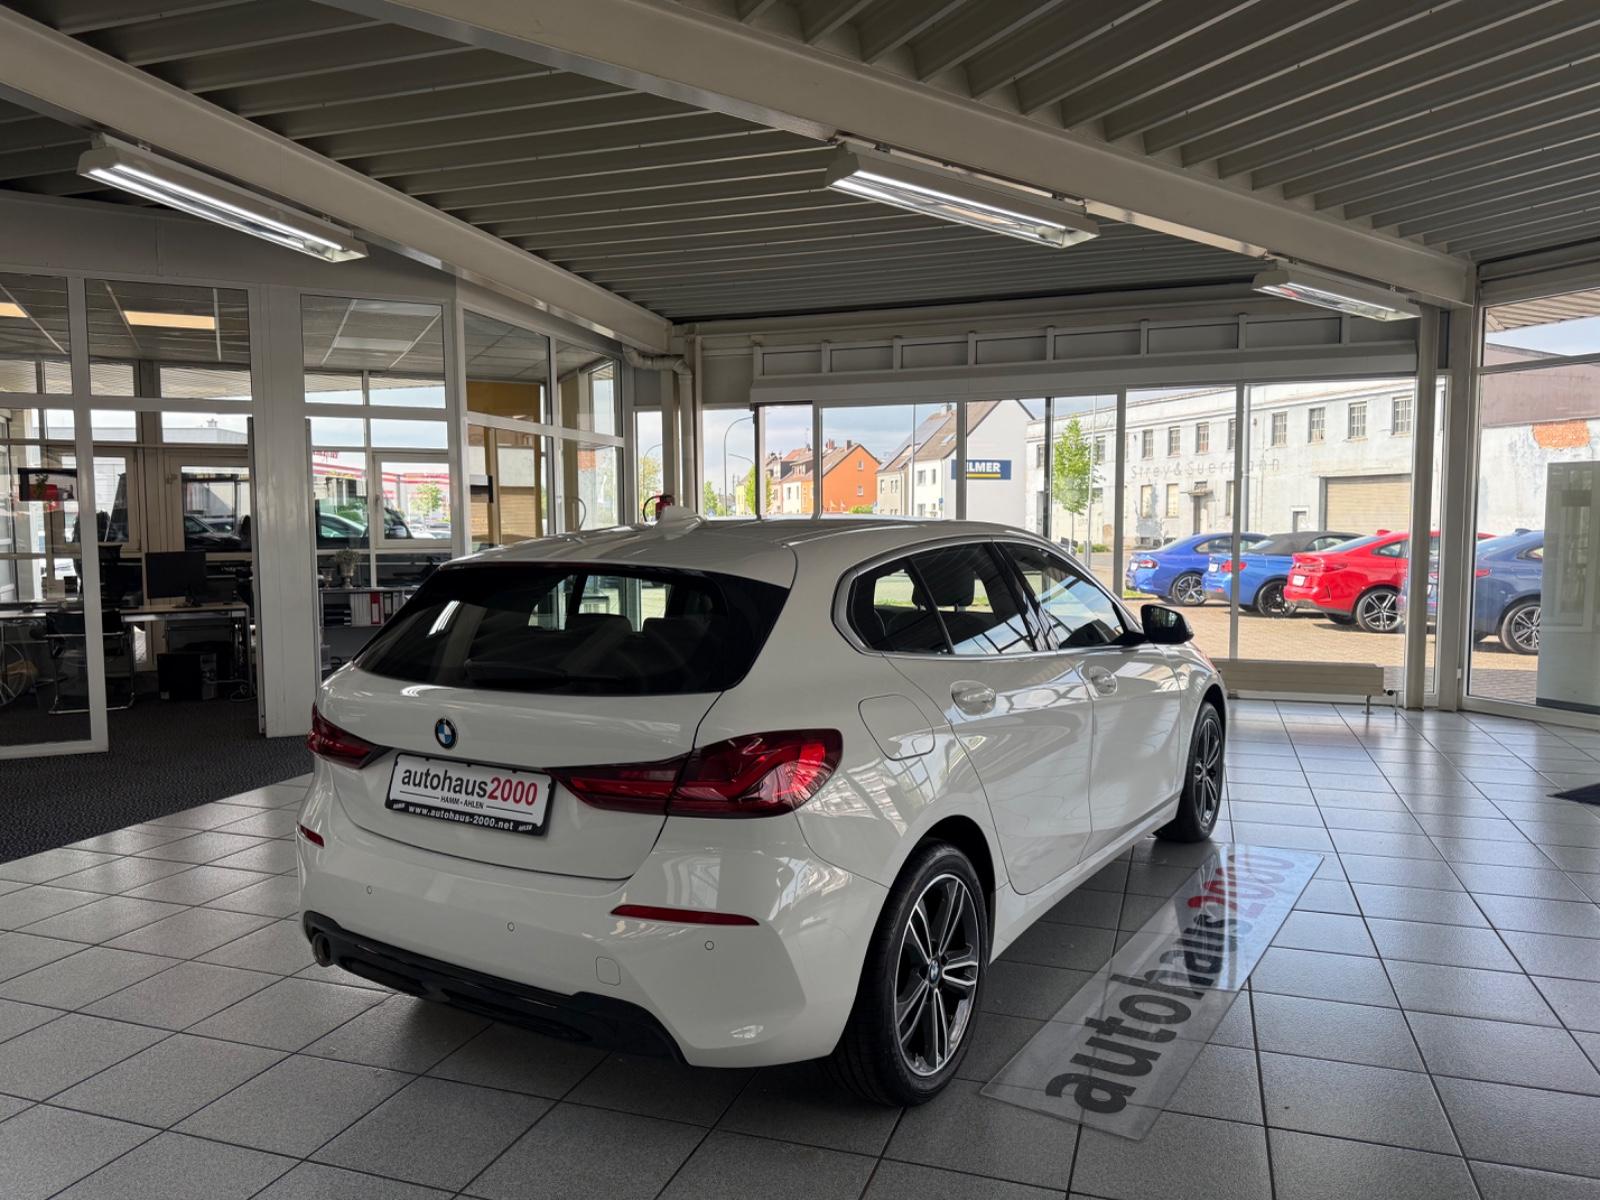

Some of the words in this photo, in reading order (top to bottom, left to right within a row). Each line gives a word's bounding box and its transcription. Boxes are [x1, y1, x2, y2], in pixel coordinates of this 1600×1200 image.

[967, 462, 1001, 473] LMER
[401, 768, 538, 806] autohaus2000
[408, 805, 514, 831] www.autohaus-2000.net
